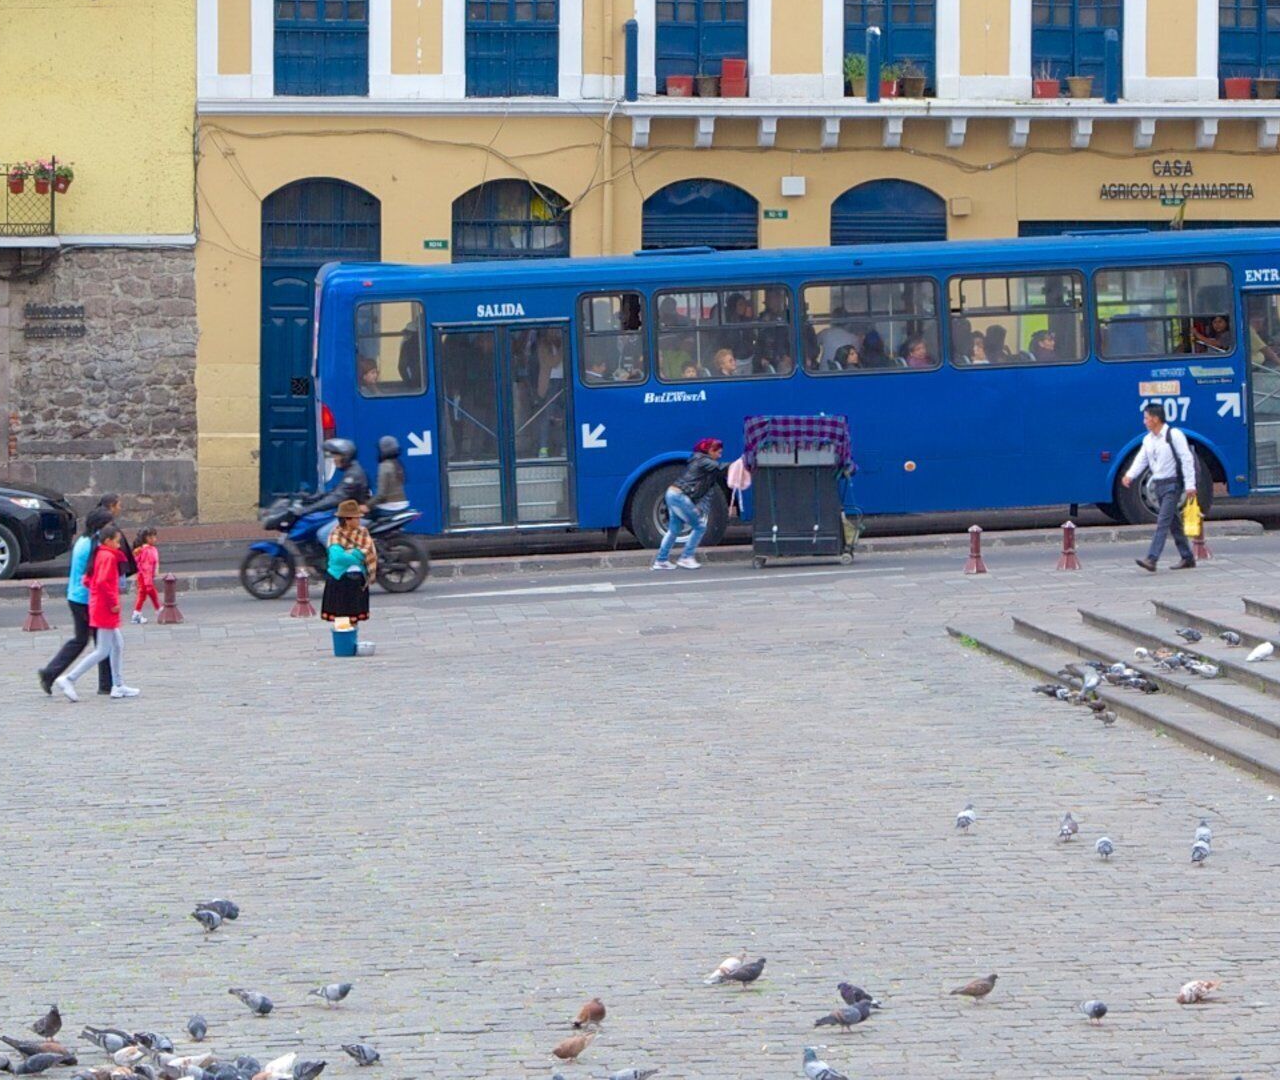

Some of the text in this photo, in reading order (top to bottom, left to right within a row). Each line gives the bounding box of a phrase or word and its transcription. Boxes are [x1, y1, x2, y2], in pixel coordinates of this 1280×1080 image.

[1152, 160, 1194, 176] CASA
[1100, 183, 1254, 199] AGRICOLA Y GANADERA
[476, 303, 525, 318] SALIDA
